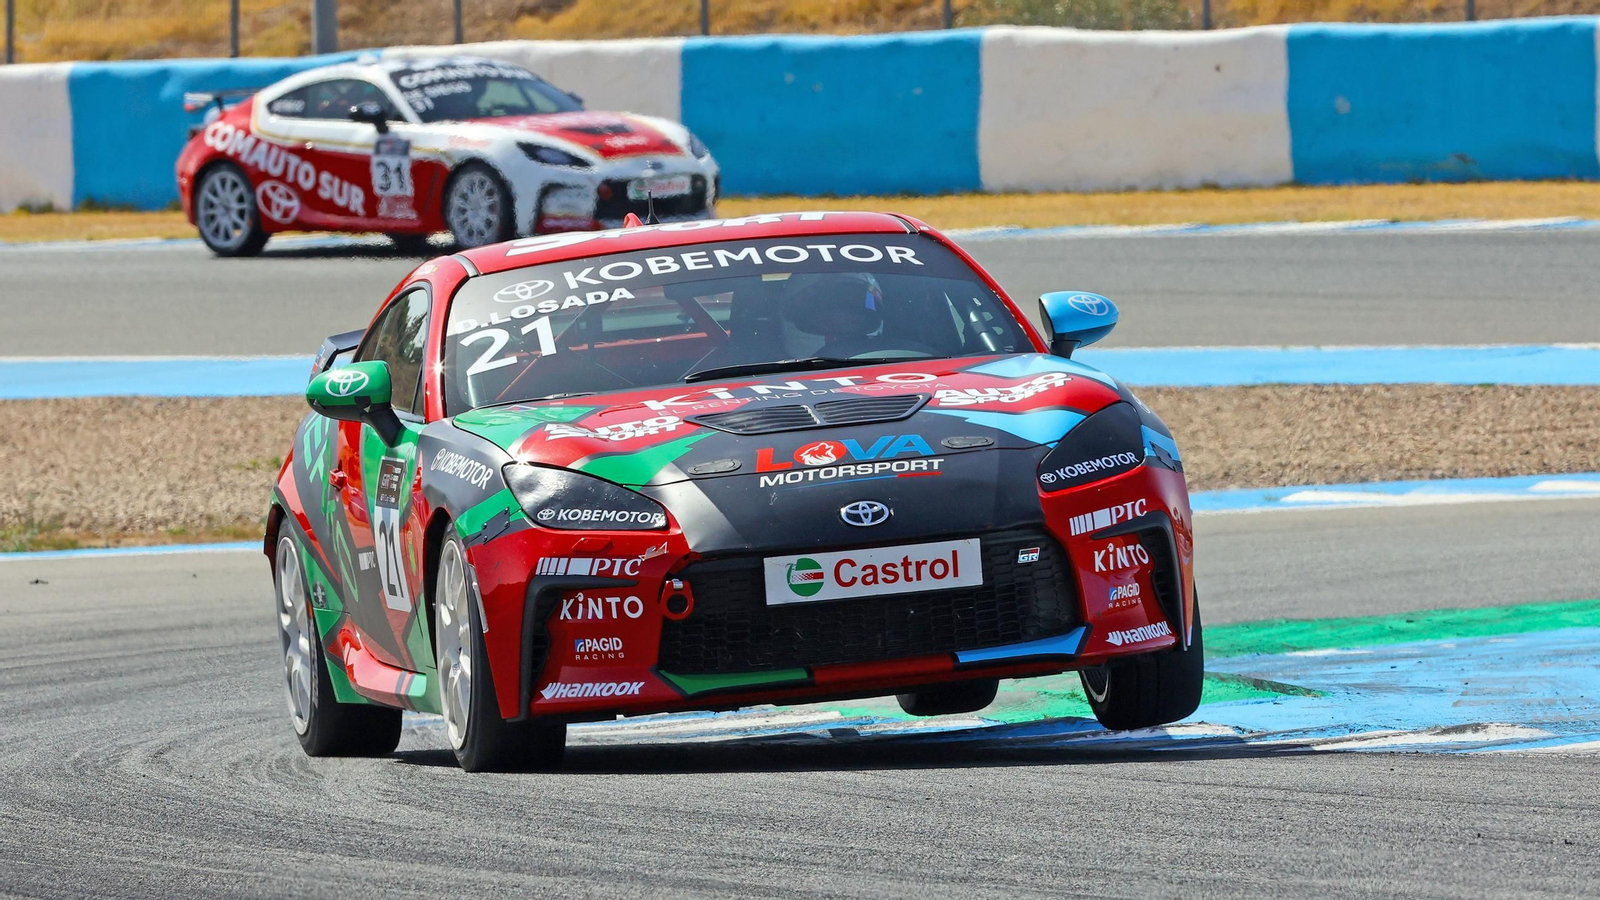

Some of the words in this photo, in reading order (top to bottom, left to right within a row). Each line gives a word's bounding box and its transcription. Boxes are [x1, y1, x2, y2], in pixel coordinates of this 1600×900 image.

[204, 121, 316, 190] COMAUTO
[318, 171, 366, 217] SUR
[375, 161, 406, 192] 31
[563, 244, 925, 290] KOBEMOTOR
[457, 287, 636, 335] D.LOSADA
[459, 315, 557, 377] 21
[691, 393, 803, 410] RENTING
[811, 388, 839, 397] DE
[839, 382, 951, 393] TOYOTA
[436, 451, 494, 490] KOBEMOTOR
[759, 458, 945, 488] MOTORSPORT
[1055, 451, 1139, 480] KOBEMOTOR
[557, 508, 663, 524] KOBEMOTOR
[1110, 498, 1148, 525] PTC
[378, 519, 404, 599] 21
[591, 557, 643, 576] PTC
[833, 549, 960, 588] Castrol
[1108, 597, 1143, 609] RACING
[1117, 582, 1140, 599] PAGID
[575, 652, 625, 660] RACING
[585, 637, 623, 652] PAGID
